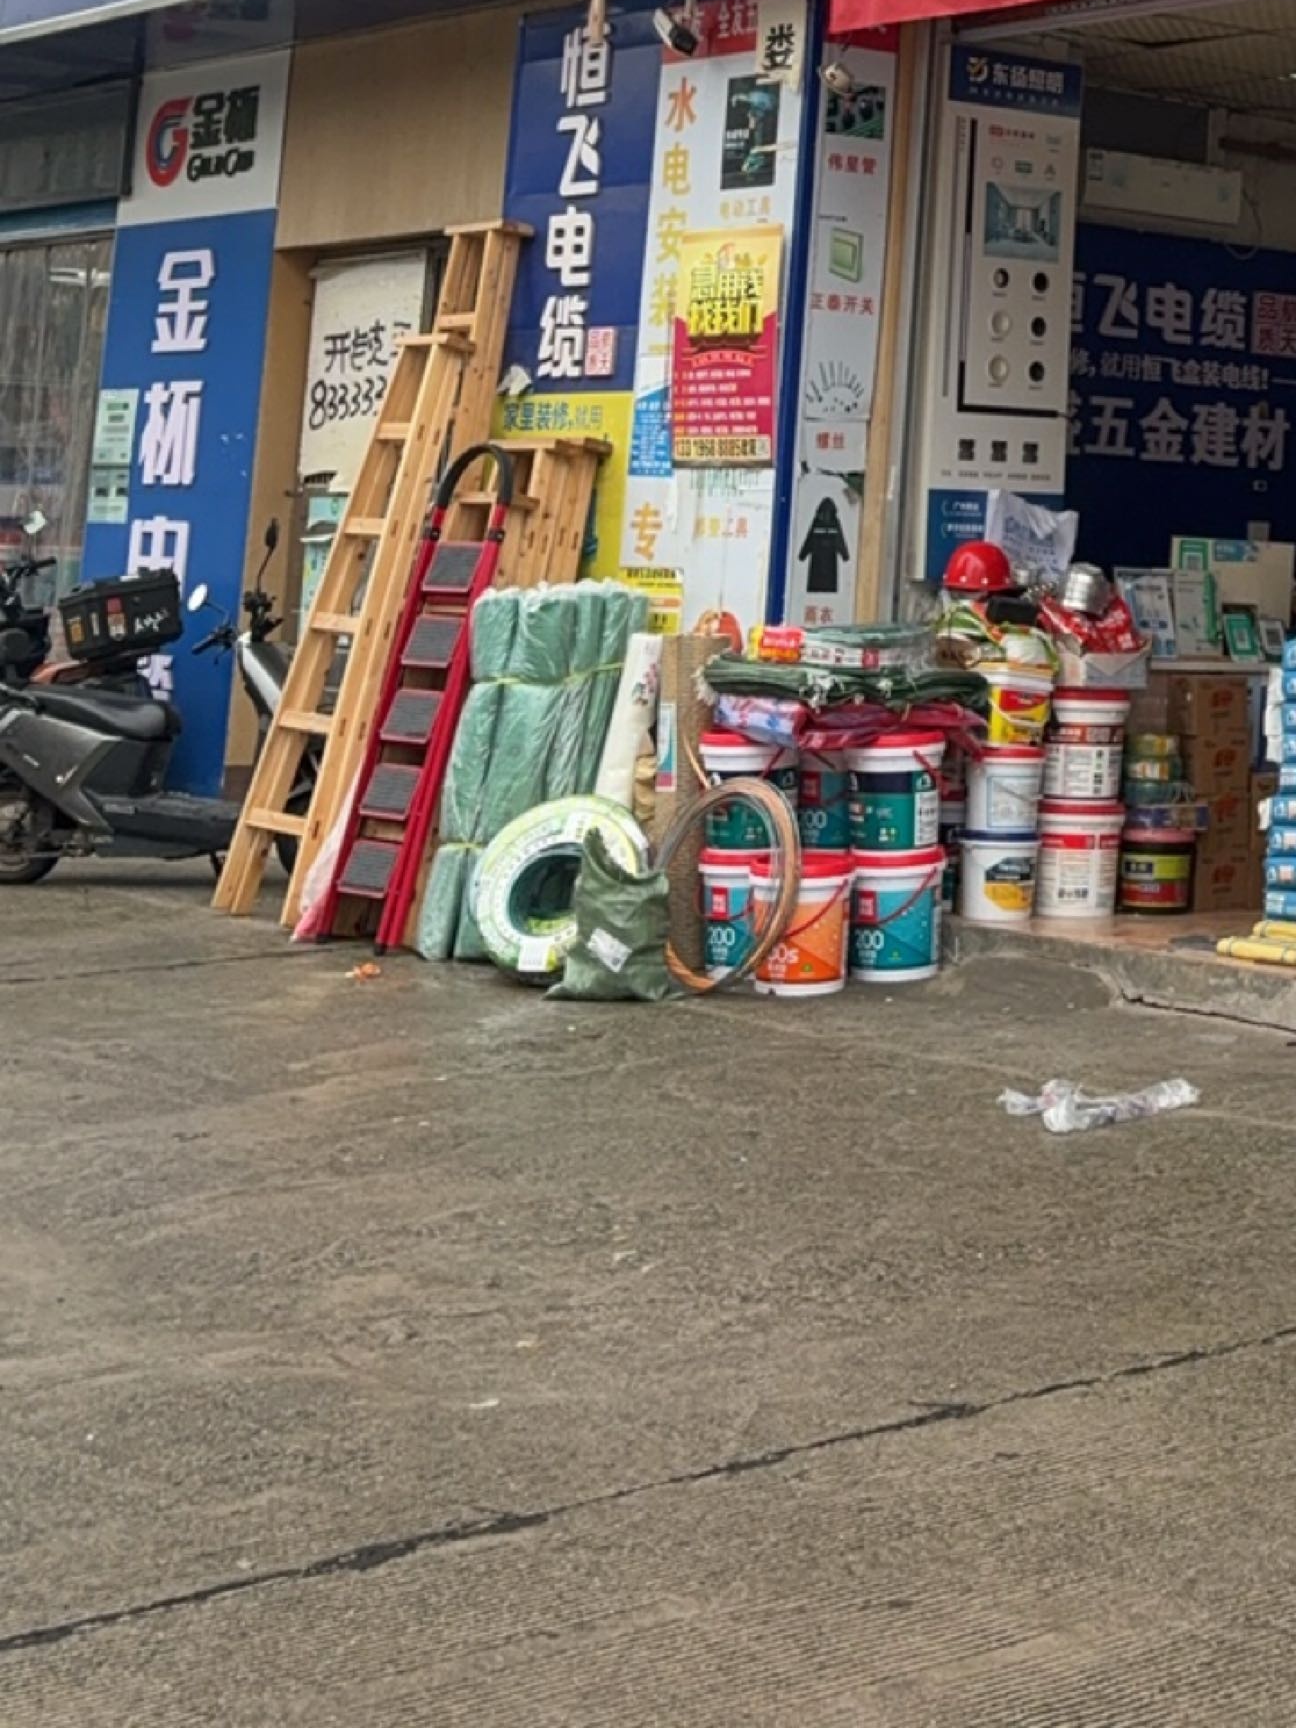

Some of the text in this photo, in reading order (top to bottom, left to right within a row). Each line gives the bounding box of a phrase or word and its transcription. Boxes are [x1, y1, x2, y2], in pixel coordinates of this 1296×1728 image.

[538, 26, 612, 378] 恒飞电缆
[127, 249, 215, 700] 金杯电
